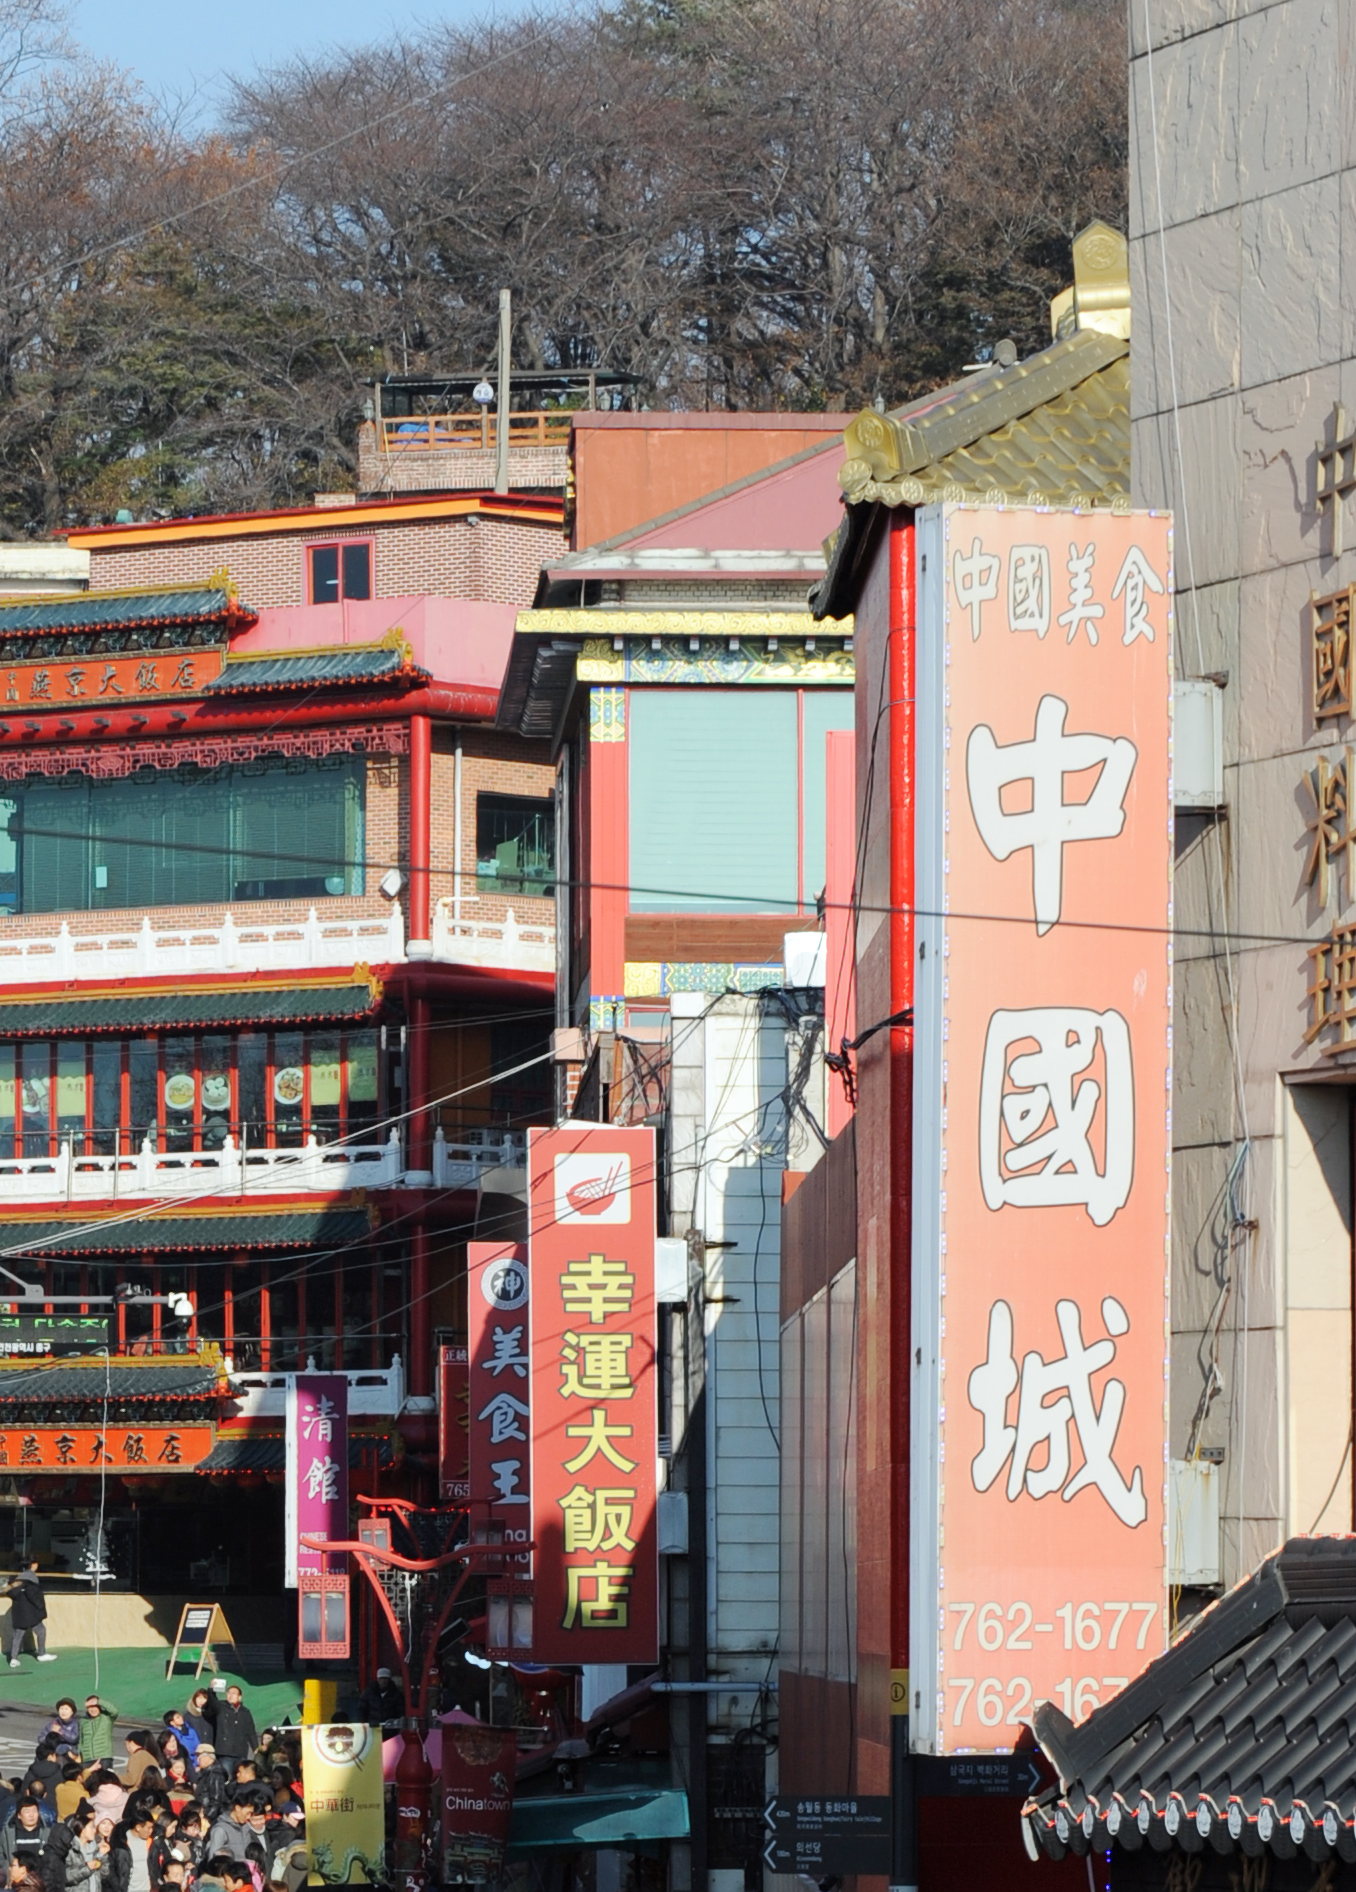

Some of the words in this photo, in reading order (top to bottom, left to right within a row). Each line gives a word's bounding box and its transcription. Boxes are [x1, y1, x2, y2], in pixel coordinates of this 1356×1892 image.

[952, 536, 1166, 648] 中國美食
[29, 658, 196, 699] 燕京大飯店
[965, 693, 1148, 1529] 中國城
[493, 1271, 521, 1298] 神
[478, 1325, 530, 1504] 美食王
[19, 1432, 183, 1464] 燕京大飯店
[558, 1253, 638, 1631] 幸運大飯店
[948, 1601, 1159, 1652] 762-1677
[949, 1764, 973, 1776] 삼국지
[976, 1763, 1009, 1776] 벽화거리
[310, 1797, 354, 1813] 中華街
[445, 1795, 512, 1811] Chinatown
[796, 1801, 821, 1814] 송월동
[824, 1801, 858, 1814] 동화마을
